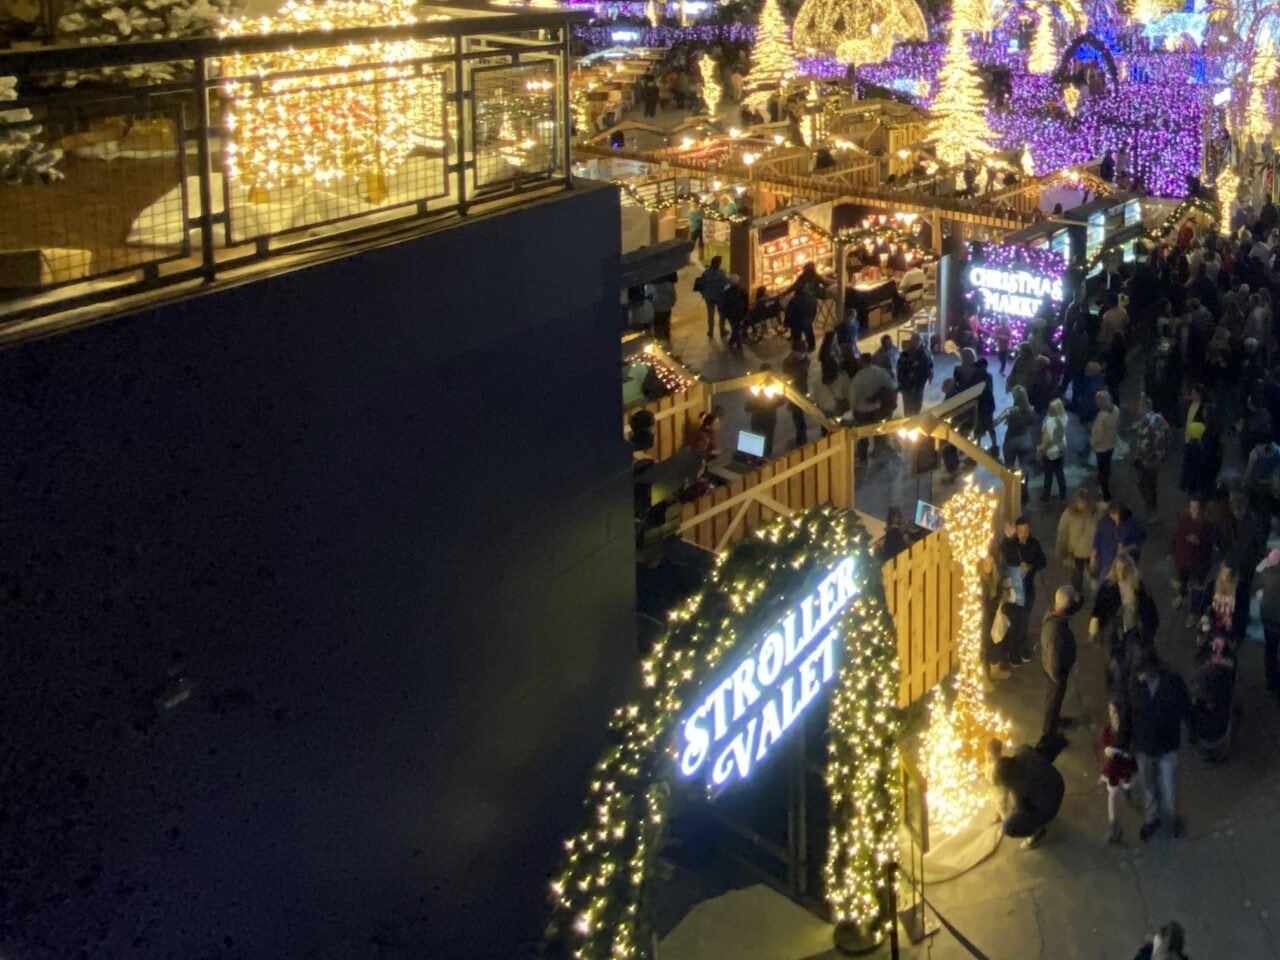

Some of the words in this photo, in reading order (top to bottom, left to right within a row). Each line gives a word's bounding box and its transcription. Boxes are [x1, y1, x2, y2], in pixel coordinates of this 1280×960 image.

[970, 267, 1063, 301] CHRISTMAS
[979, 287, 1043, 317] MARKET
[681, 557, 860, 776] STROLLER
[712, 631, 838, 783] VALET
